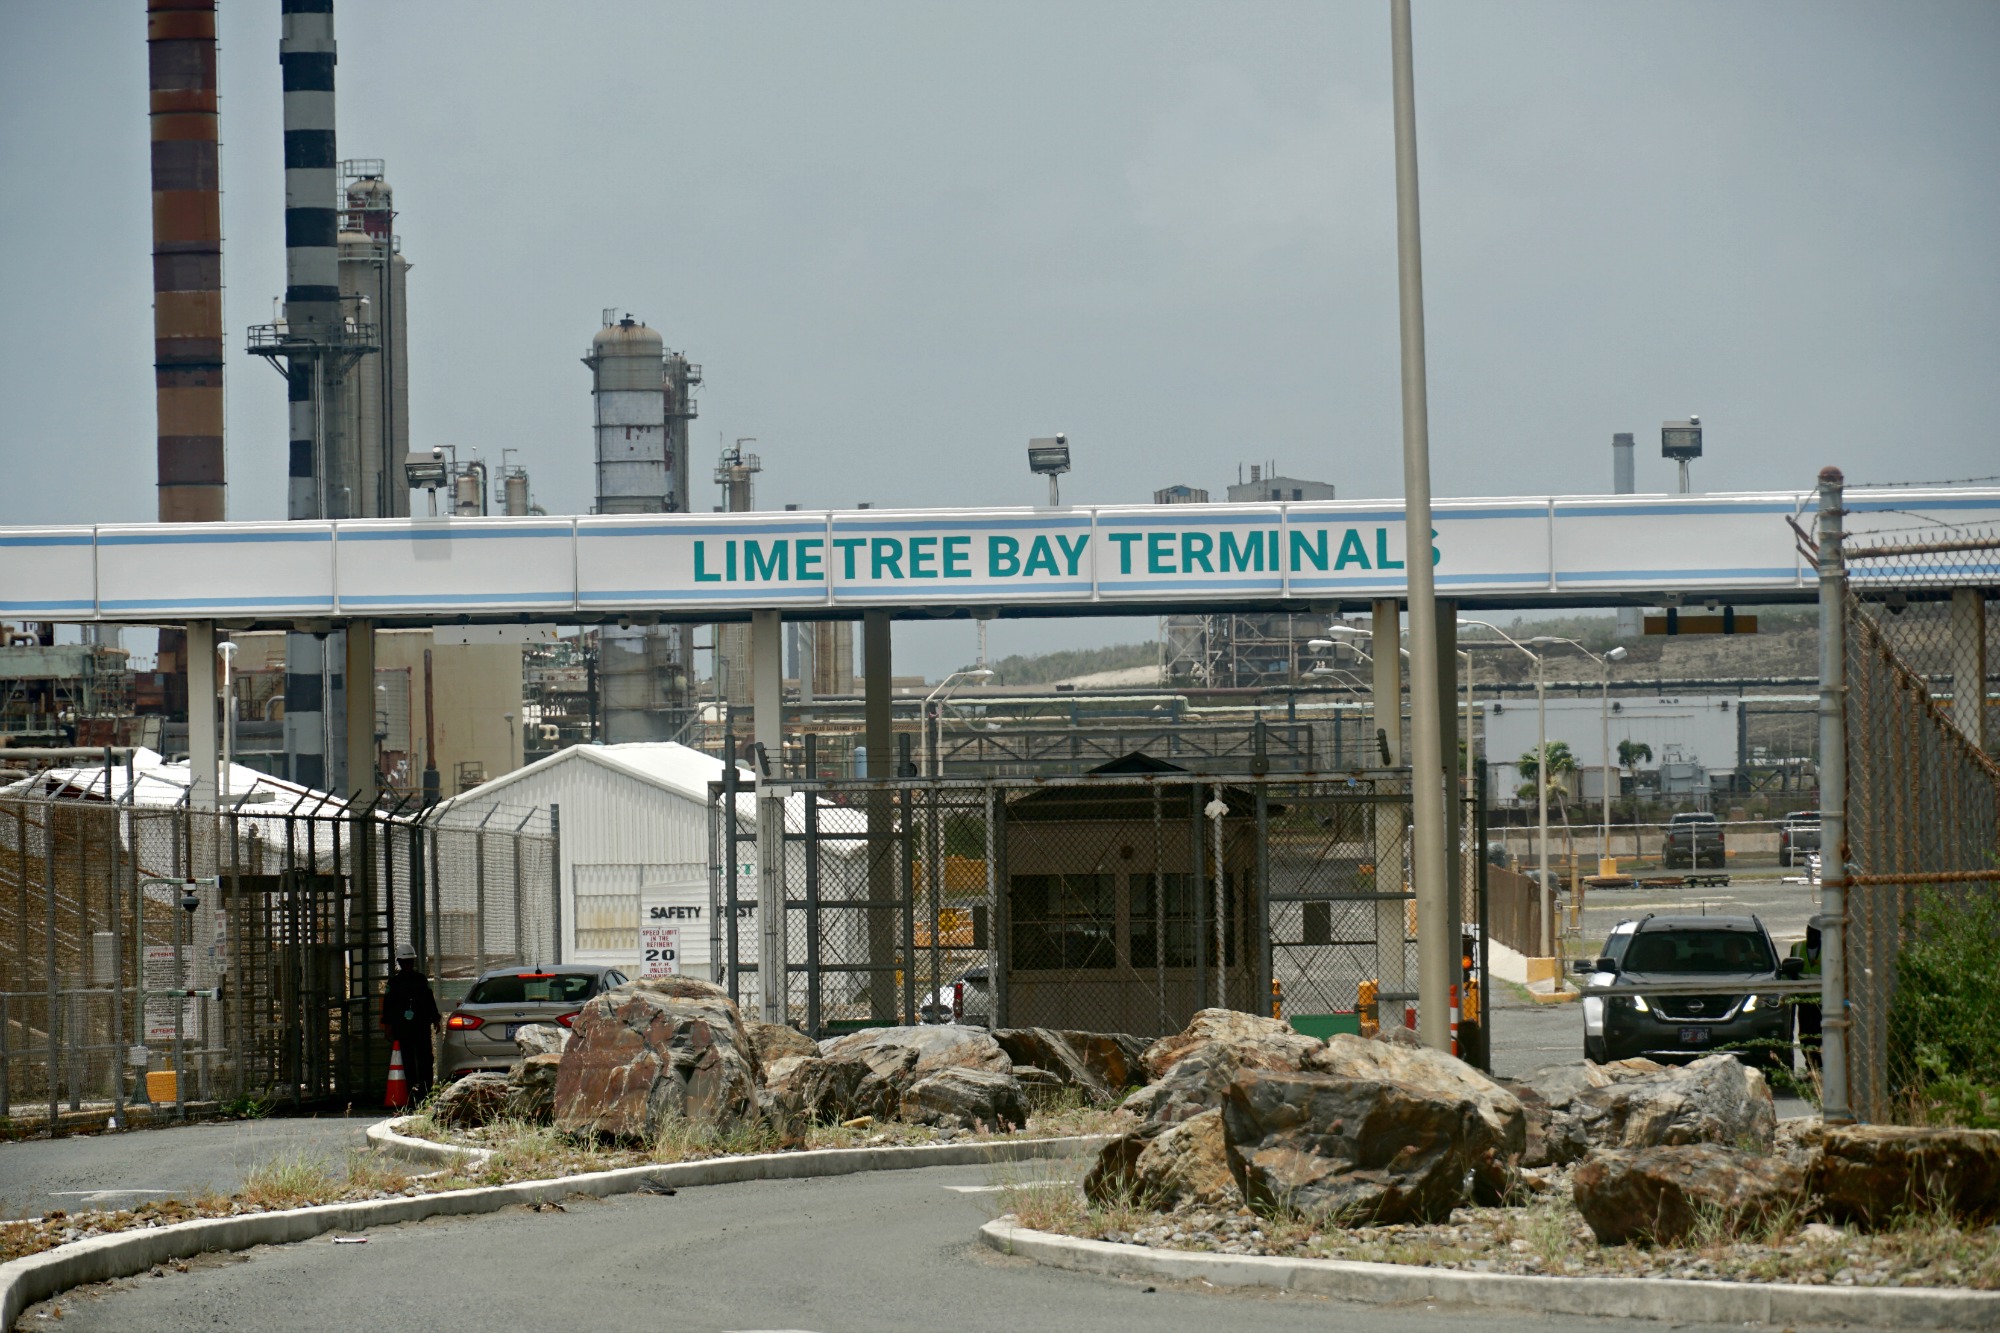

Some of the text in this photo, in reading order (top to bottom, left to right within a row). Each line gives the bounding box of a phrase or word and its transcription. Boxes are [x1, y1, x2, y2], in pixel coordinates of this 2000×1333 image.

[694, 538, 970, 582] LIMETREE
[988, 535, 1090, 577] BAY
[650, 906, 701, 919] SAFETY
[645, 949, 675, 962] 20
